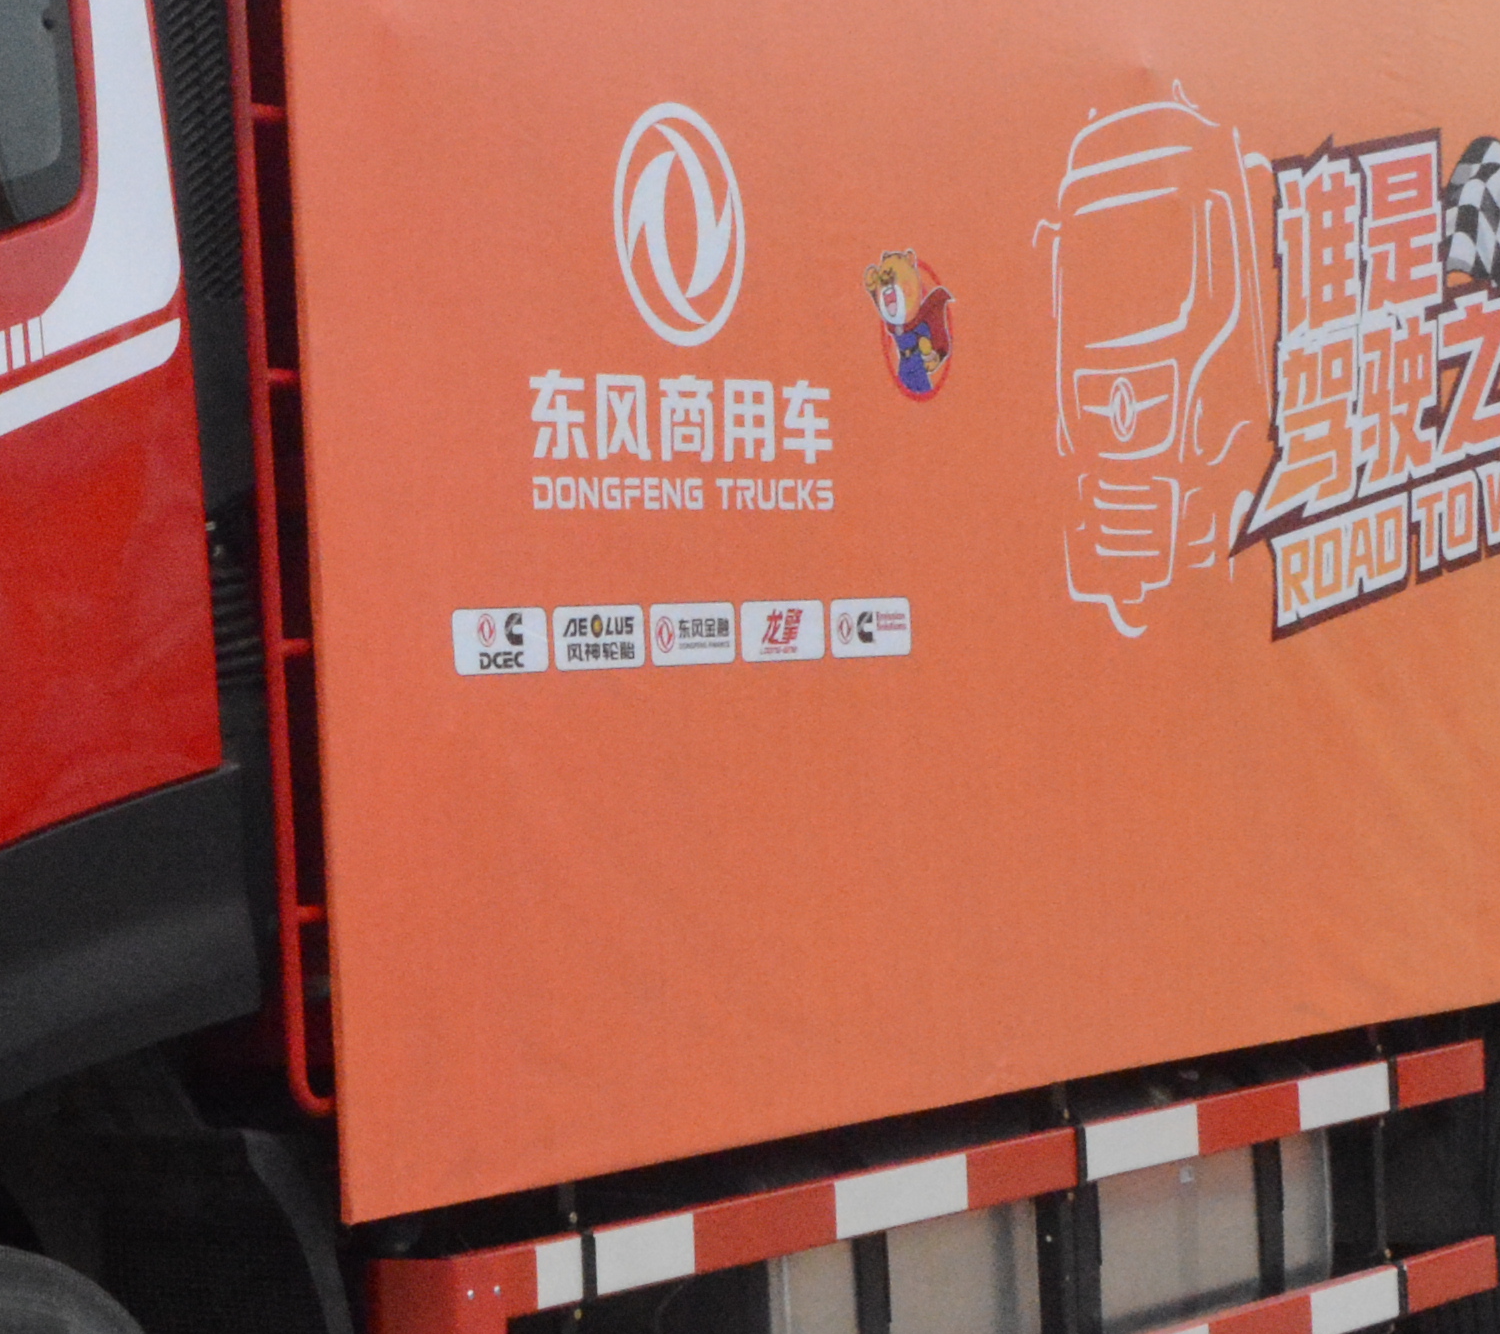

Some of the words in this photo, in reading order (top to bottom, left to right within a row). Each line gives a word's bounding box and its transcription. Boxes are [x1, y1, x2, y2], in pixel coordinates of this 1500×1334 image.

[1280, 143, 1442, 339] 谁是
[529, 369, 833, 464] 东风商用车
[532, 476, 704, 510] DONGFENG
[715, 478, 835, 510] TRUCKS
[1275, 497, 1408, 622] ROAD
[1411, 479, 1479, 569] TO
[563, 614, 635, 638] AEOLUS
[678, 617, 730, 638] 东风金融
[479, 651, 525, 670] DCEC
[567, 642, 635, 662] 风神轮胎
